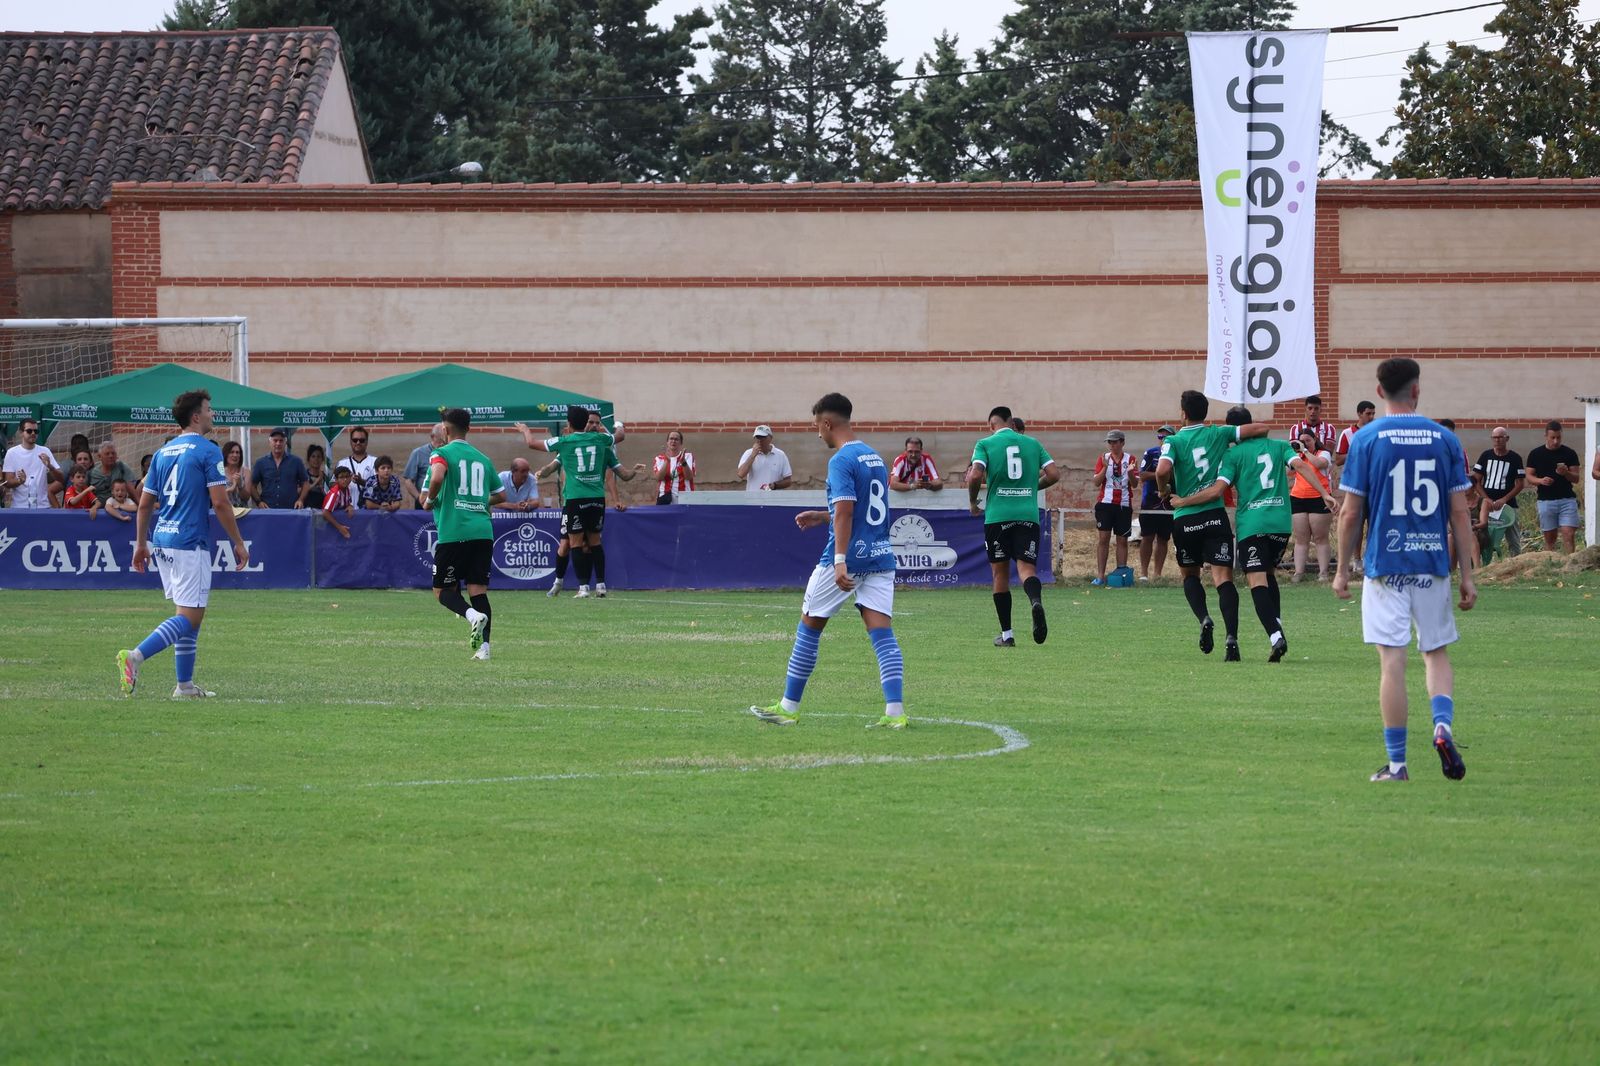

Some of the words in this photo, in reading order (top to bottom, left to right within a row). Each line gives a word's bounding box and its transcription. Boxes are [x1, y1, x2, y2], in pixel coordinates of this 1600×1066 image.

[1226, 36, 1295, 398] synergias
[0, 406, 32, 414] RURAL
[350, 409, 372, 417] CAJA
[374, 408, 404, 417] RURAL
[475, 406, 505, 414] RURAL
[548, 404, 568, 412] CAJA
[1378, 429, 1432, 439] AYUNTAMIENTO
[1390, 436, 1432, 445] VILLARALBO
[575, 446, 597, 473] 17
[1006, 445, 1023, 480] 6
[1192, 446, 1210, 481] 5
[458, 459, 485, 497] 10
[1257, 453, 1275, 490] 2
[163, 464, 179, 506] 4
[1388, 459, 1440, 516] 15
[866, 479, 886, 526] 8
[491, 511, 537, 519] DISTRIBUIDOR
[890, 516, 932, 539] LACTEAS
[1184, 519, 1222, 532] leomor.net
[503, 540, 551, 552] Estrella
[1403, 542, 1443, 551] ZAMORA
[21, 539, 120, 576] CAJA
[505, 553, 549, 566] Galicia
[906, 571, 931, 583] desde
[934, 573, 959, 584] 1929
